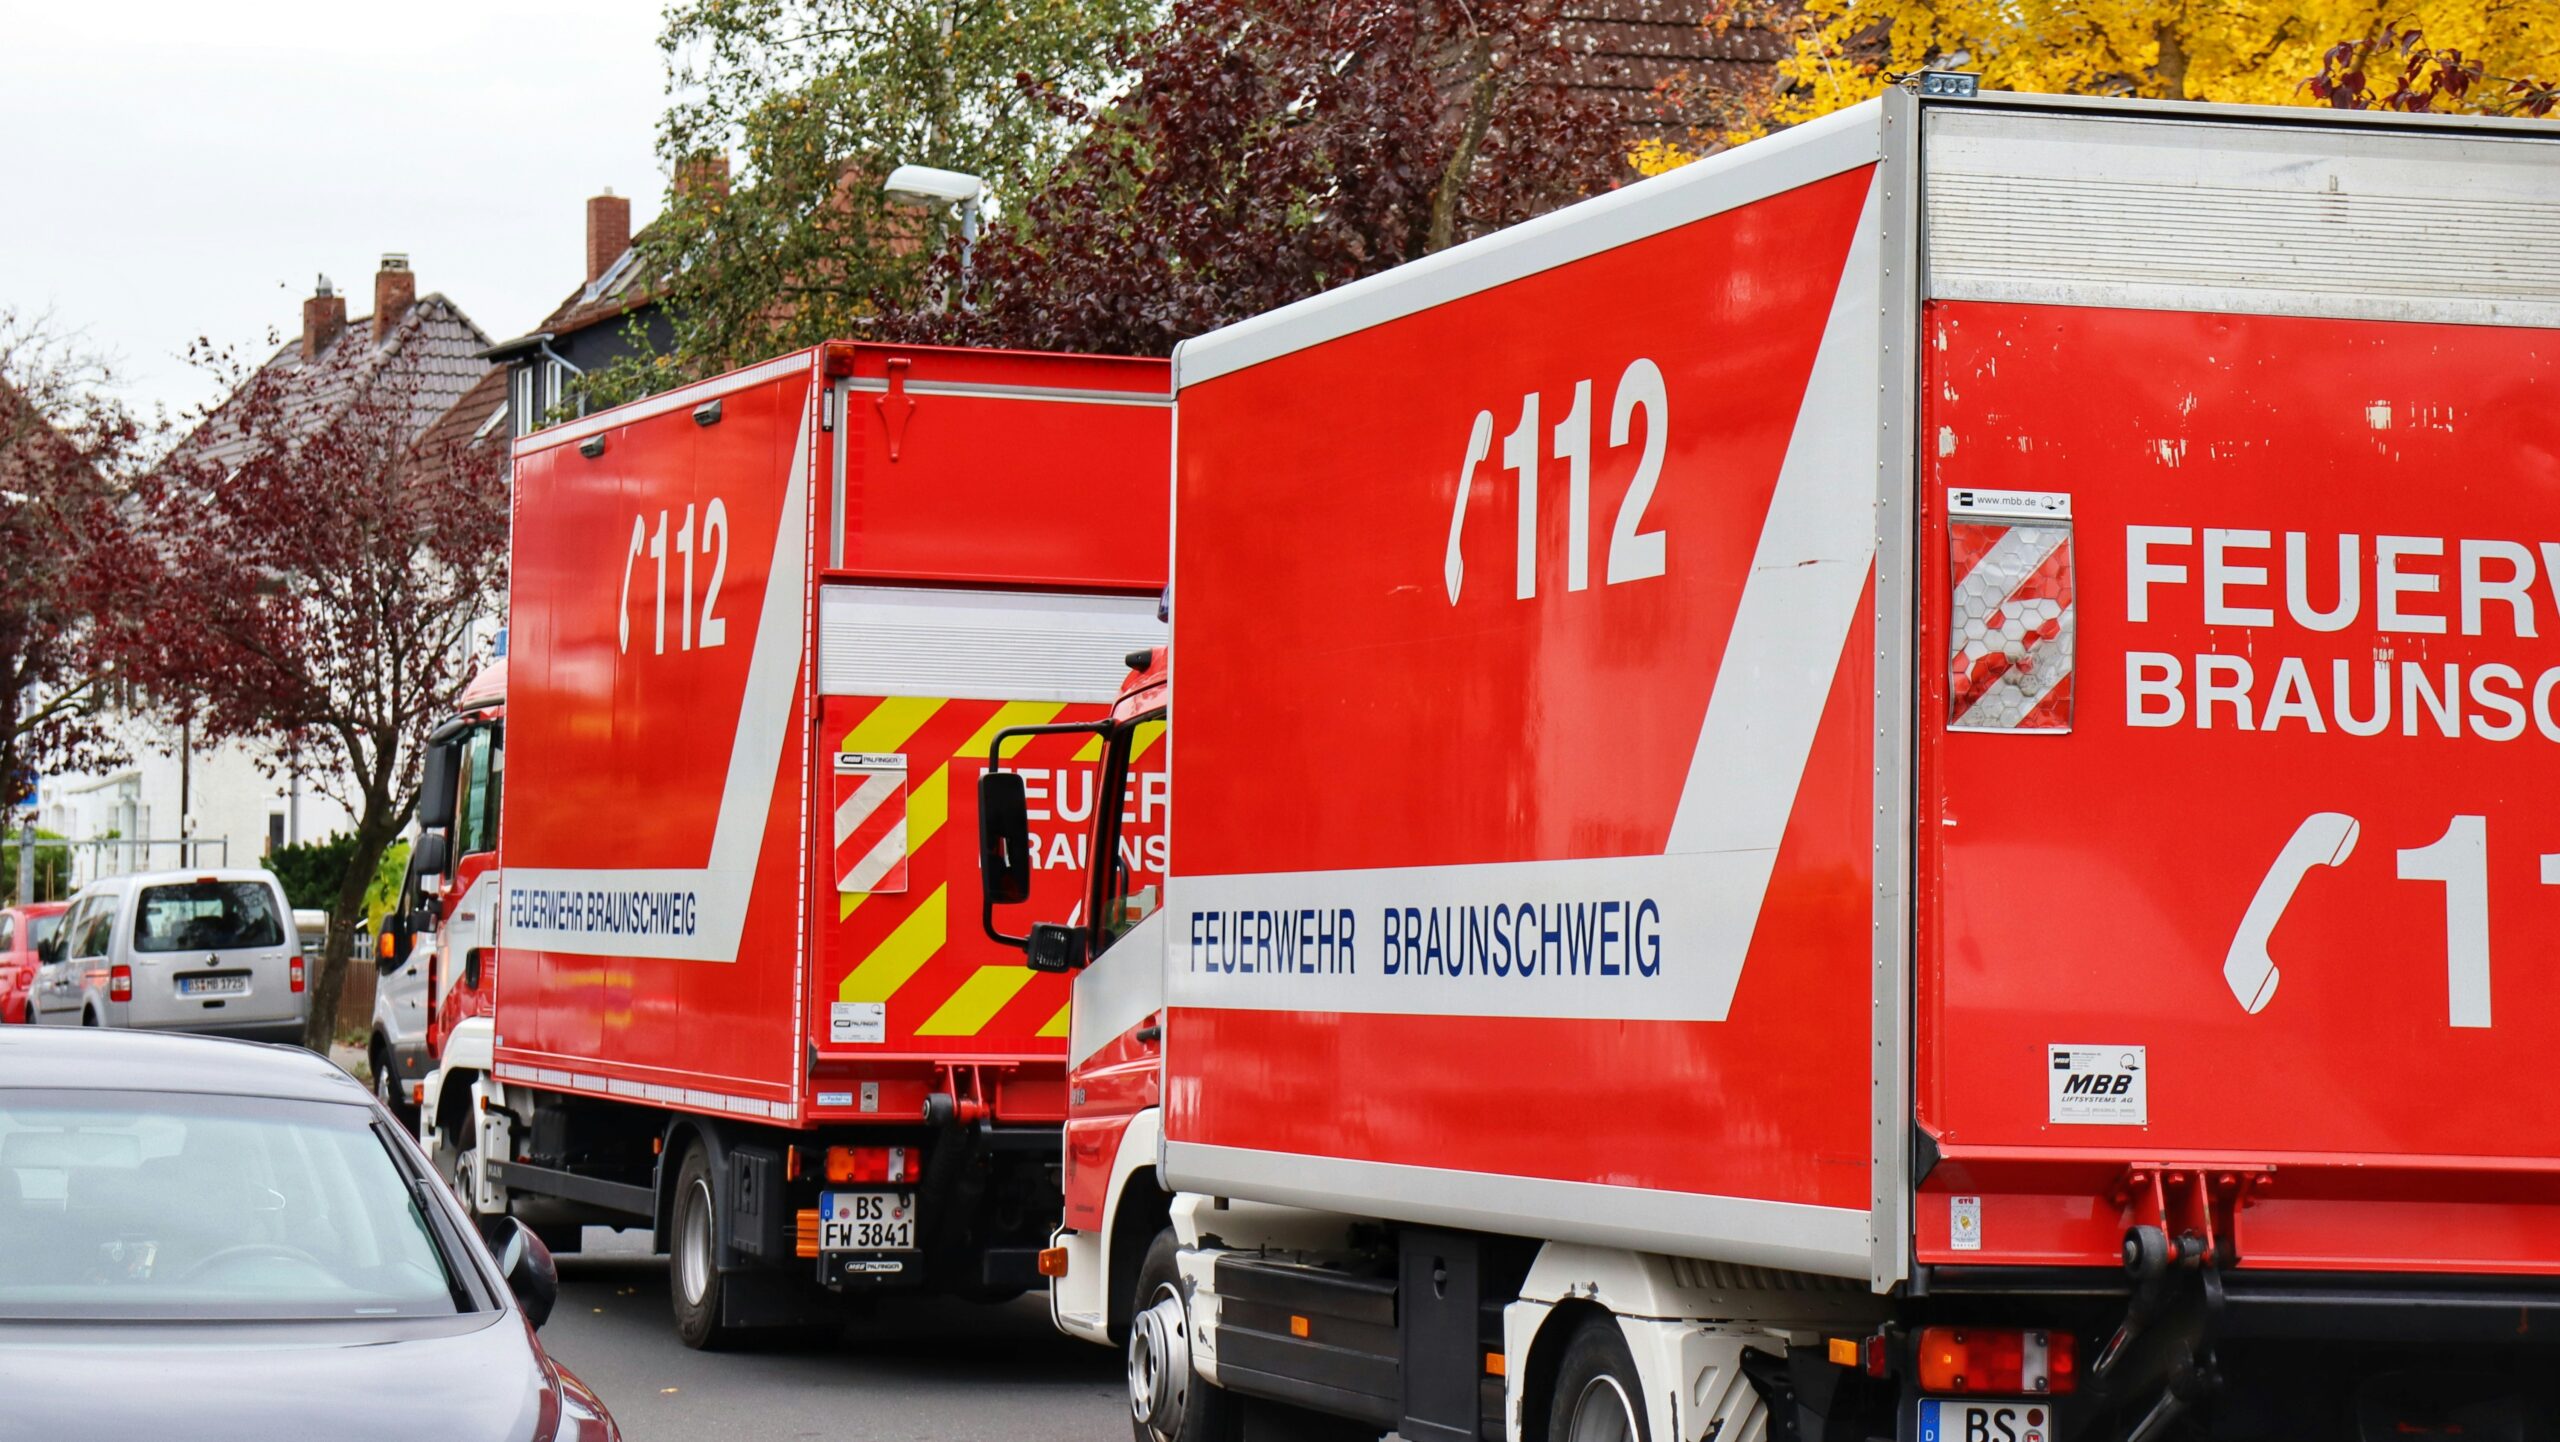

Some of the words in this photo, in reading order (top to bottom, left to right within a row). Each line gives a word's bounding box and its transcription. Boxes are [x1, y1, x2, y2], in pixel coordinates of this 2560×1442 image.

[1503, 358, 1668, 600] 112
[1977, 497, 2036, 507] www.mbb.de
[650, 497, 728, 655] 112
[509, 889, 583, 931] FEUERWEHR
[586, 891, 696, 936] BRAUNSCHWEIG
[2396, 815, 2560, 1028] 1
[1191, 908, 1355, 974] FEUERWEHR
[1383, 898, 1660, 977] BRAUNSCHWEIG
[2063, 1074, 2133, 1094] MBB
[856, 1196, 883, 1220] BS
[825, 1223, 852, 1247] FW
[858, 1223, 909, 1247] 3841
[1925, 1430, 1934, 1442] D
[1966, 1408, 2016, 1442] BS
